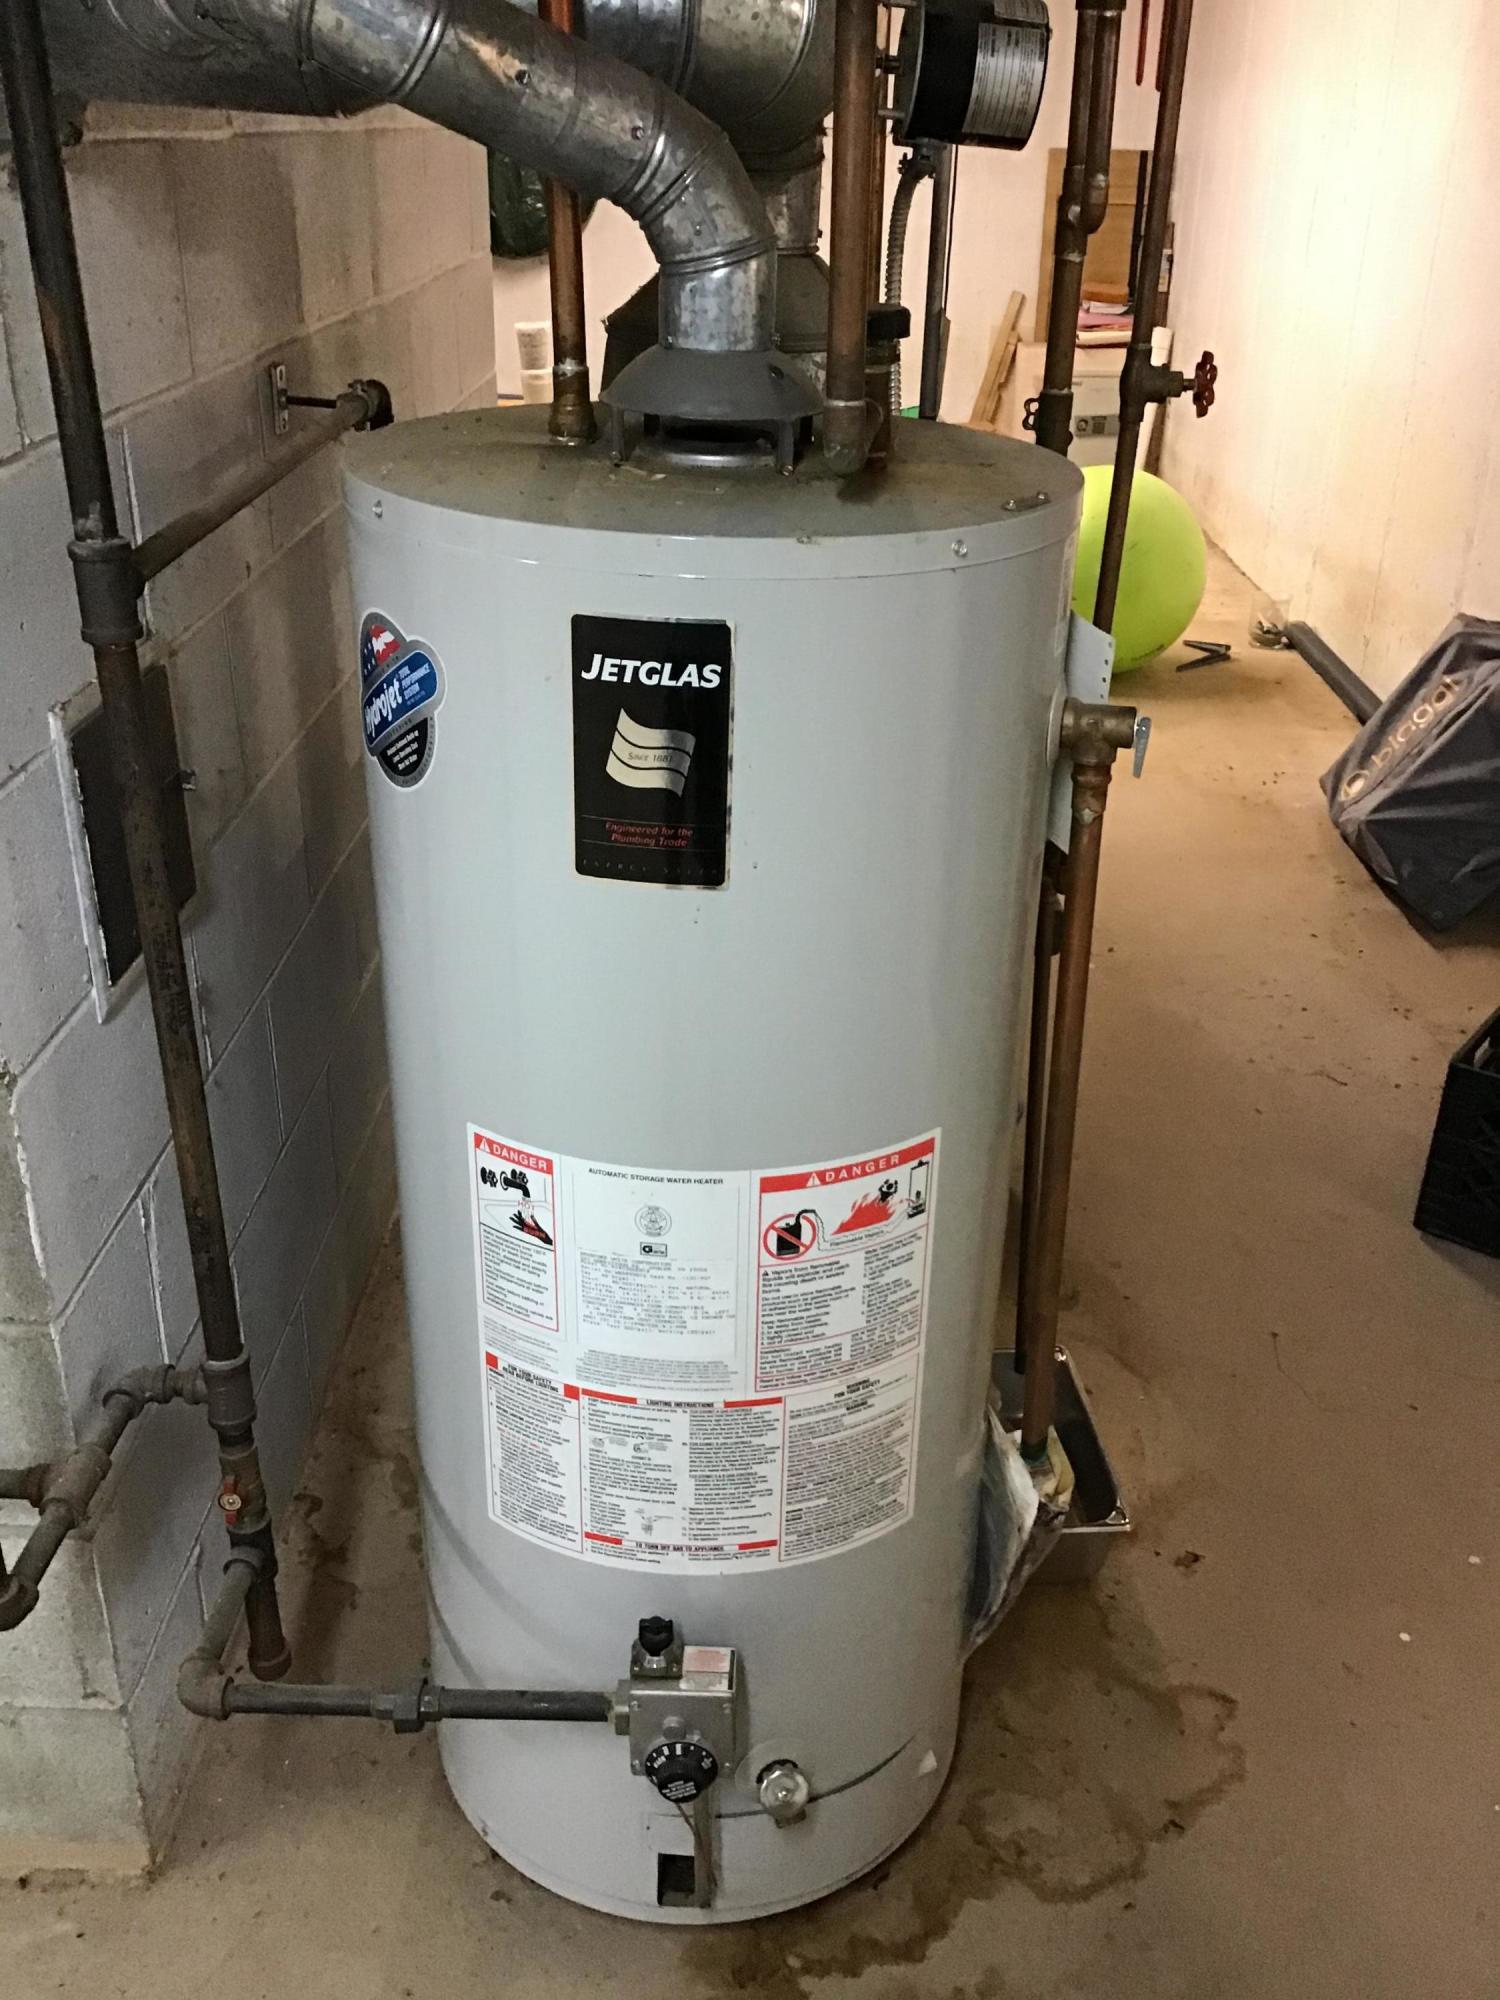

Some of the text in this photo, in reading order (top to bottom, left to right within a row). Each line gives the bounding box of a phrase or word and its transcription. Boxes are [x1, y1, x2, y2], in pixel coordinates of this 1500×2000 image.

[582, 653, 722, 688] JETGLAS
[606, 822, 658, 835] Engineered
[678, 828, 693, 837] the
[611, 833, 688, 847] Plumbing Trade
[493, 1144, 547, 1171] DANGER
[588, 1167, 628, 1179] AUTOMATIC
[630, 1174, 665, 1183] STORAGE
[825, 1155, 899, 1182] DANGER
[646, 1399, 672, 1407] LIGHTING
